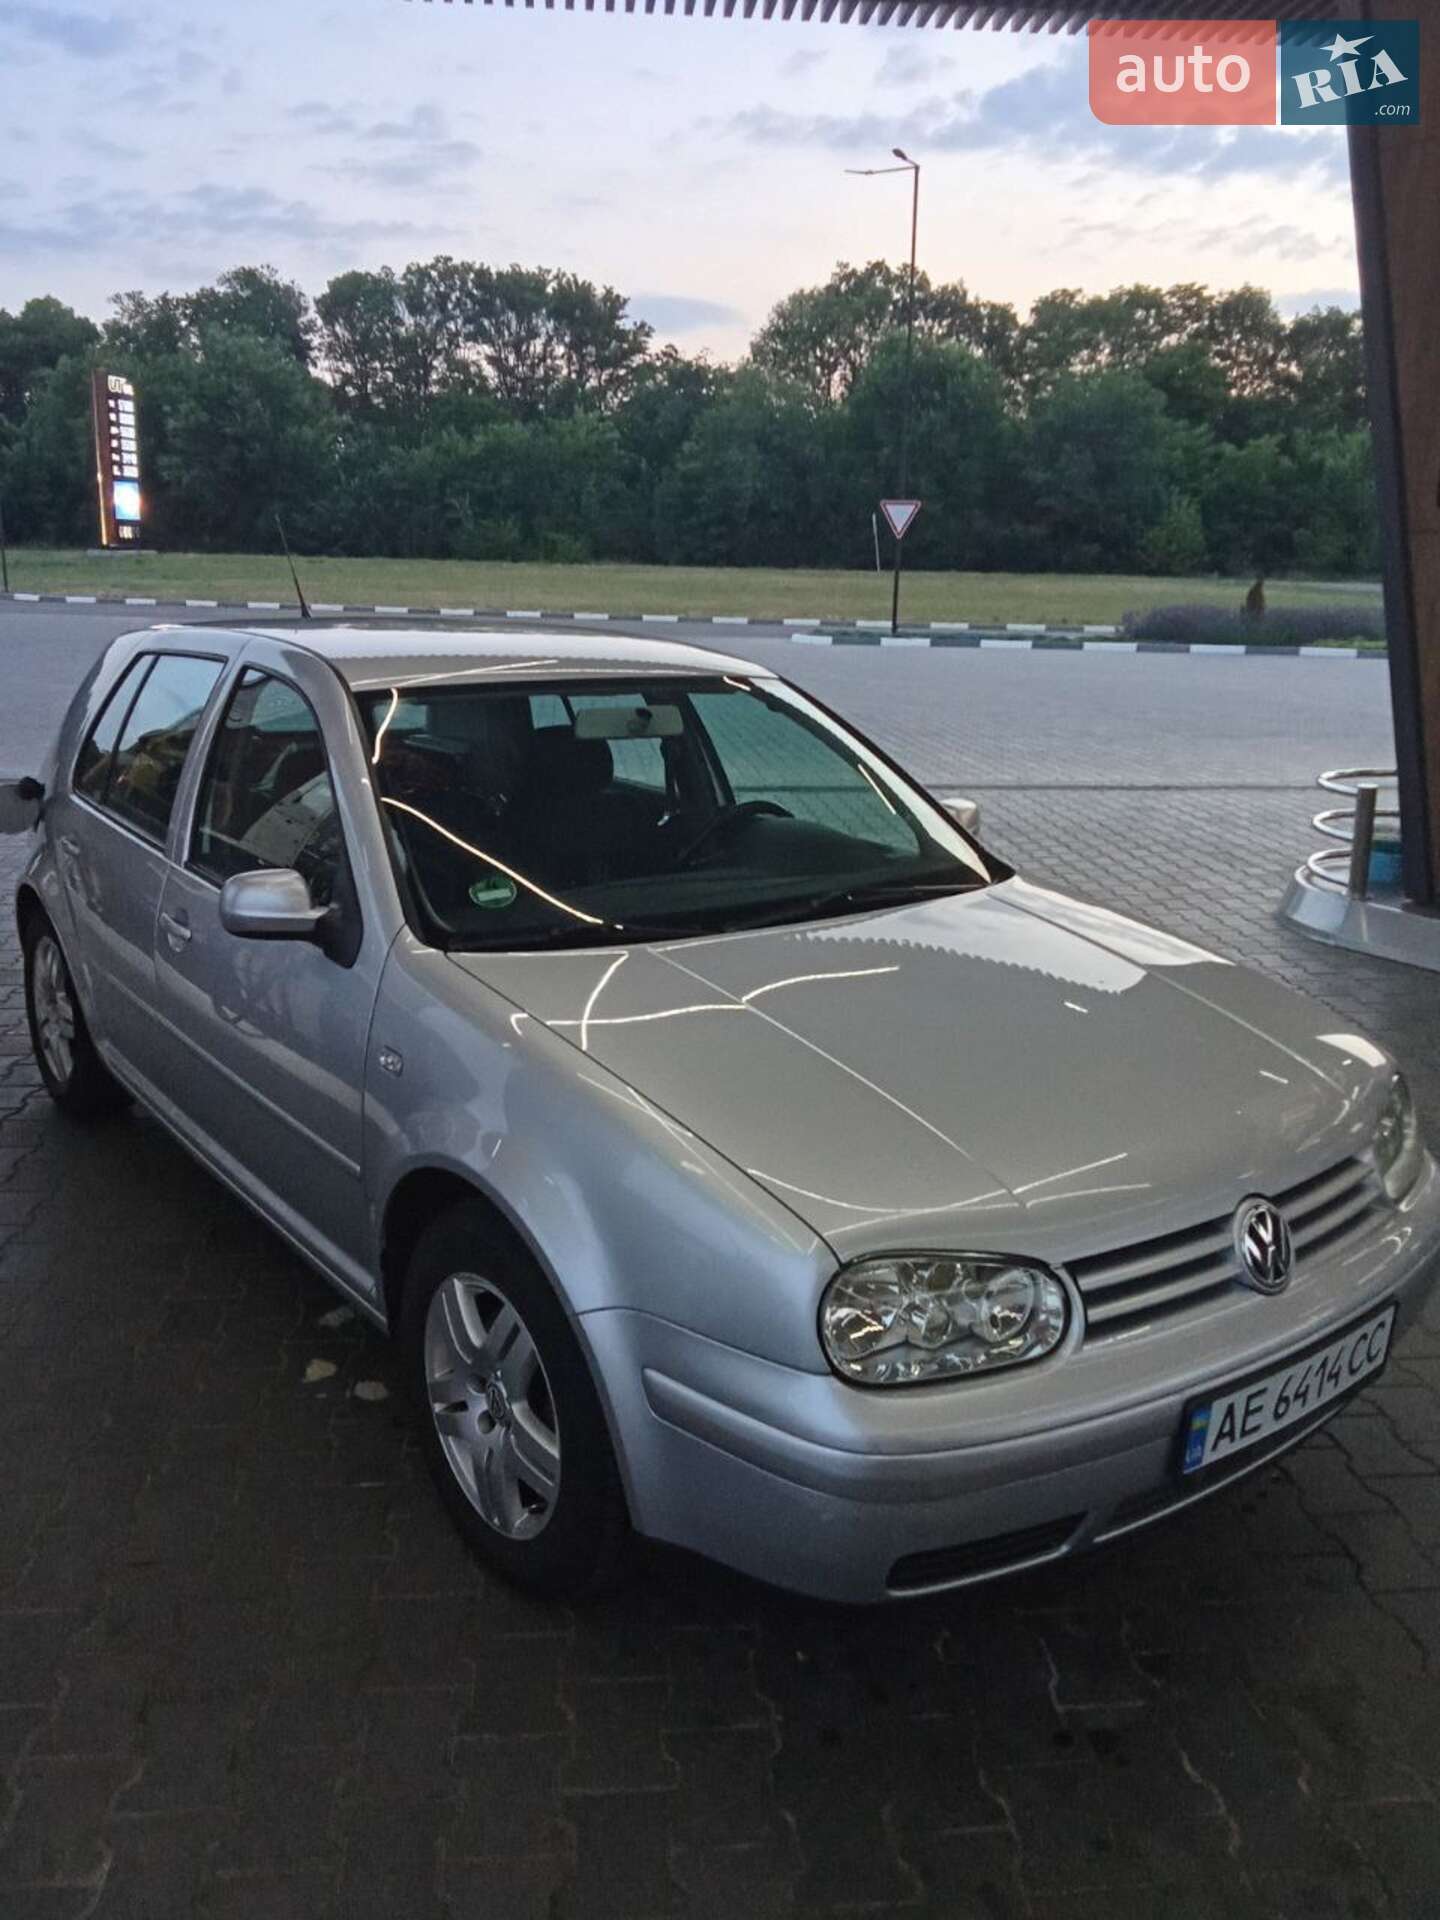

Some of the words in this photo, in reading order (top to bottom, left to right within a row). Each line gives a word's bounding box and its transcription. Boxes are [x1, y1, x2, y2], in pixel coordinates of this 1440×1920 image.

[1211, 1386, 1268, 1451] AE
[1272, 1345, 1345, 1422] 6414
[1348, 1319, 1386, 1376] CC
